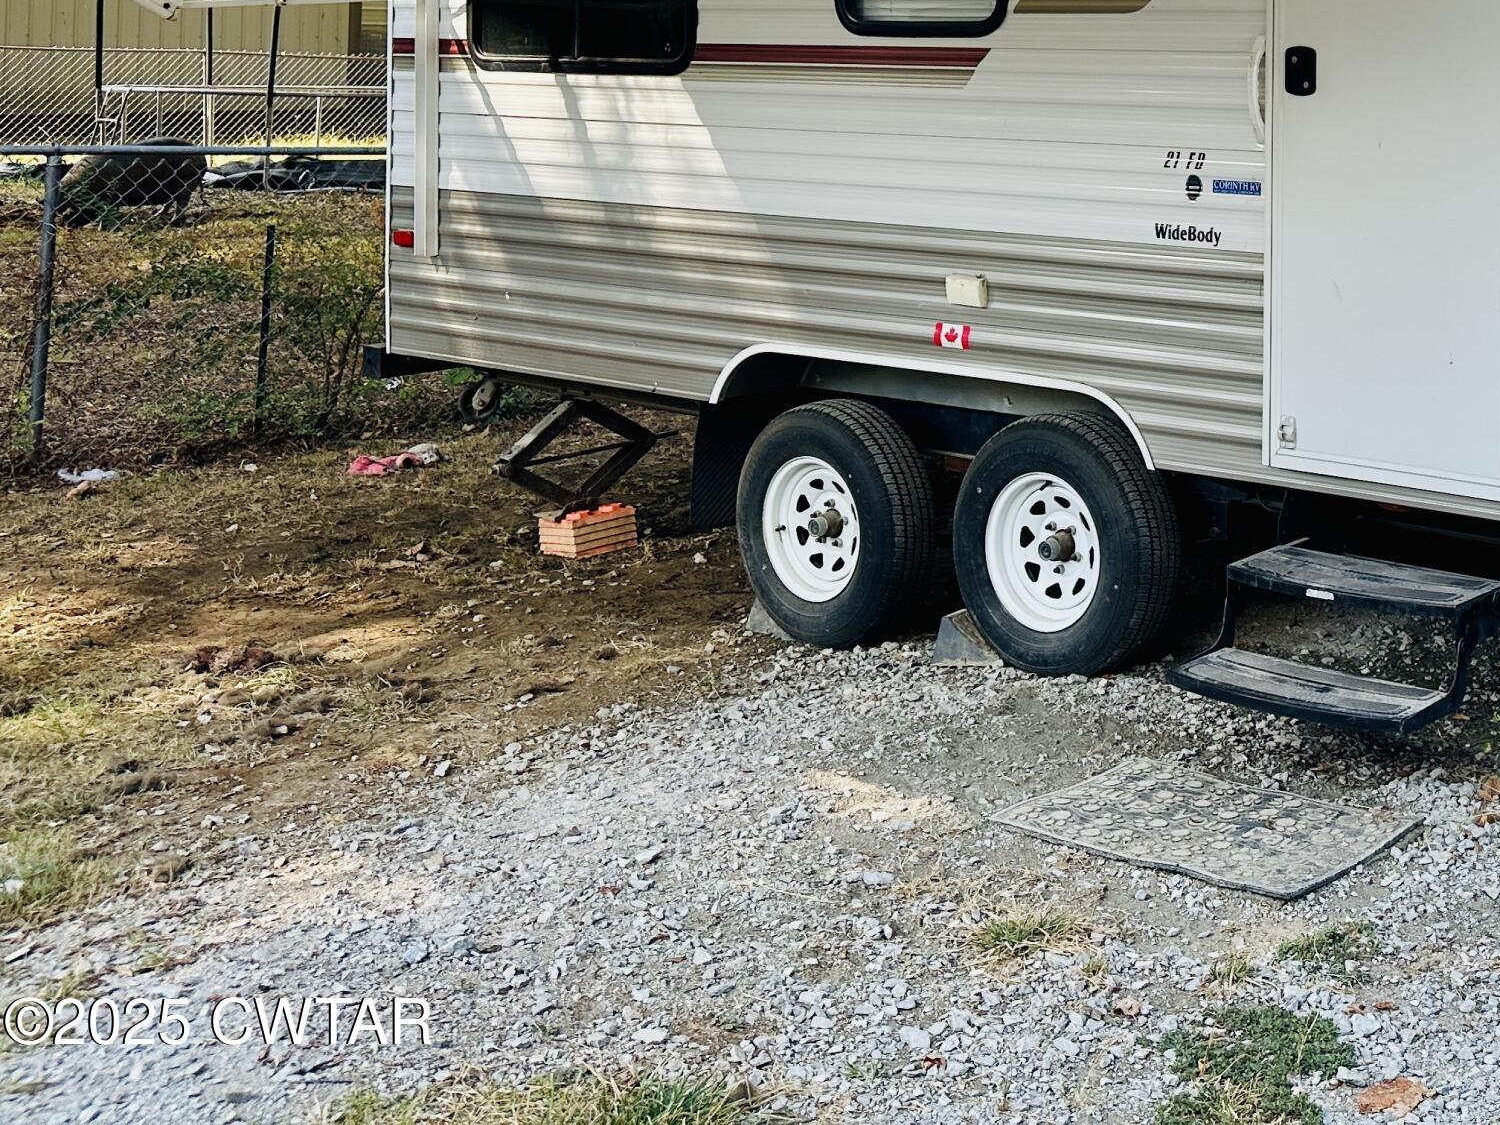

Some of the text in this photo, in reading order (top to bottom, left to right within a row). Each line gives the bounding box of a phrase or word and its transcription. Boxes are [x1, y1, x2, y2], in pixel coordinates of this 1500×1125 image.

[1163, 151, 1181, 168] 21
[1213, 180, 1249, 191] CORINTH
[1155, 223, 1221, 247] WideBody
